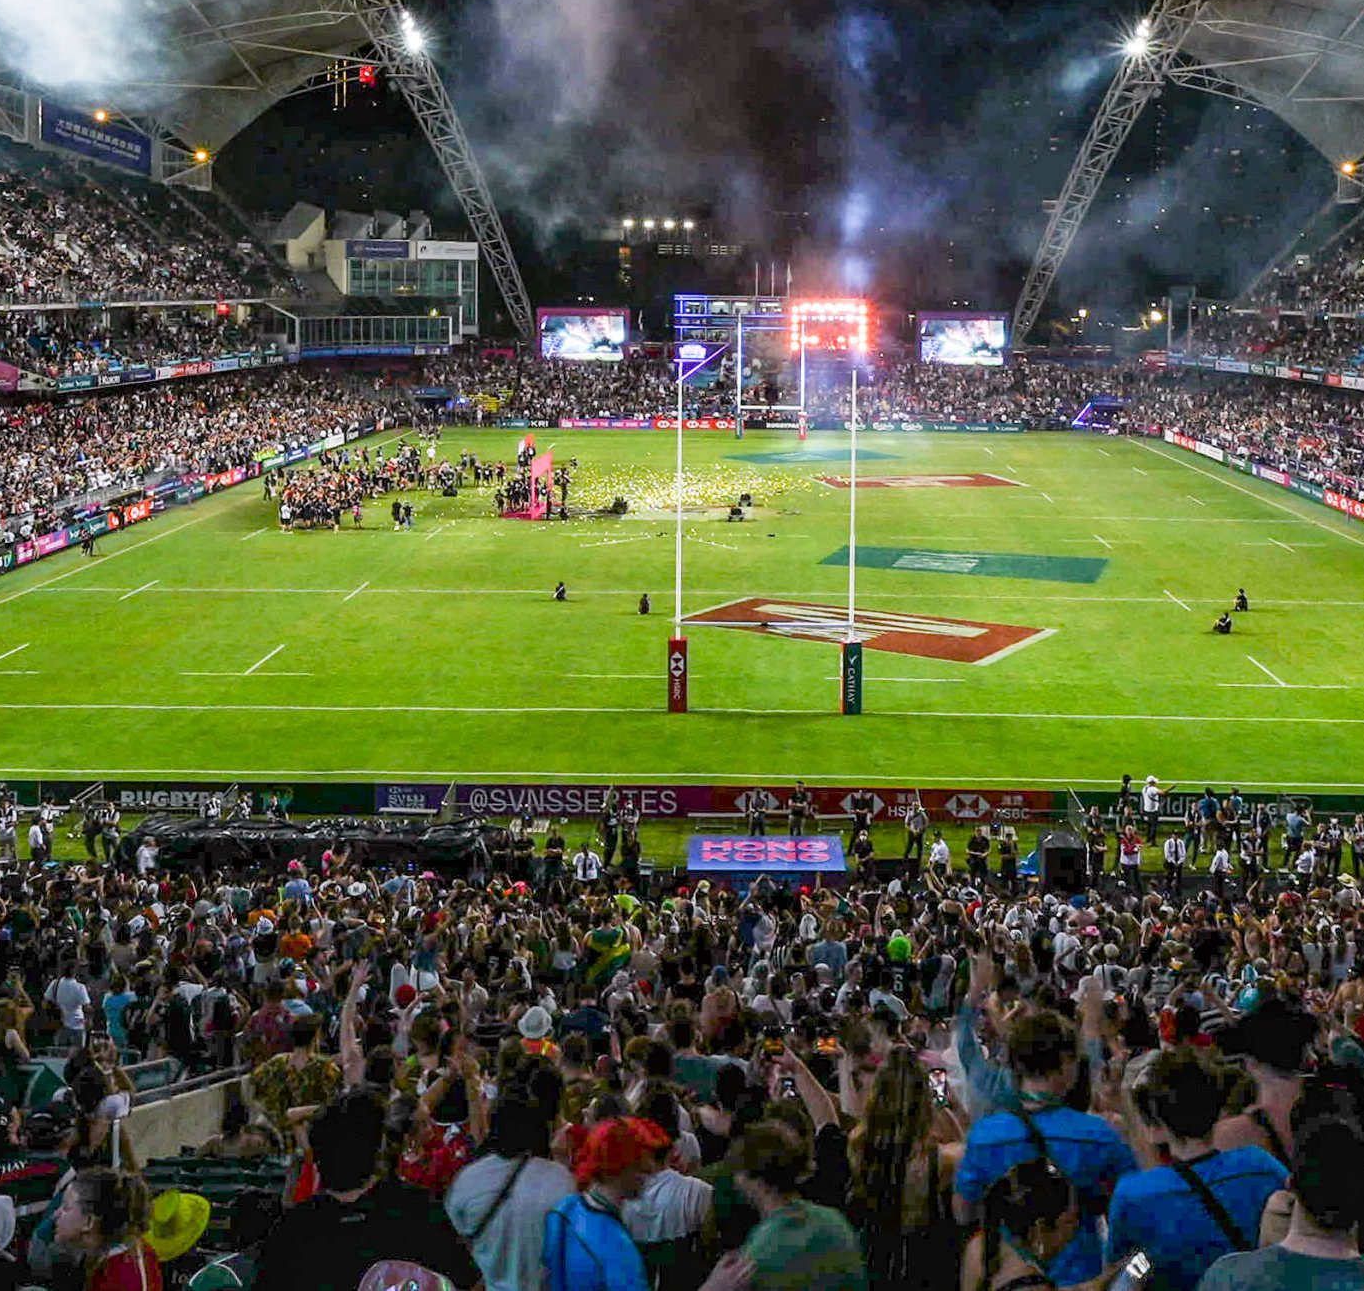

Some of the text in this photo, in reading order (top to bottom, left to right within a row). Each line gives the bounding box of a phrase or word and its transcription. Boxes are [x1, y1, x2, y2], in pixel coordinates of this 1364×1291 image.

[848, 668, 856, 704] CATHAY
[701, 840, 829, 851] HONG
[701, 851, 831, 863] KONG
